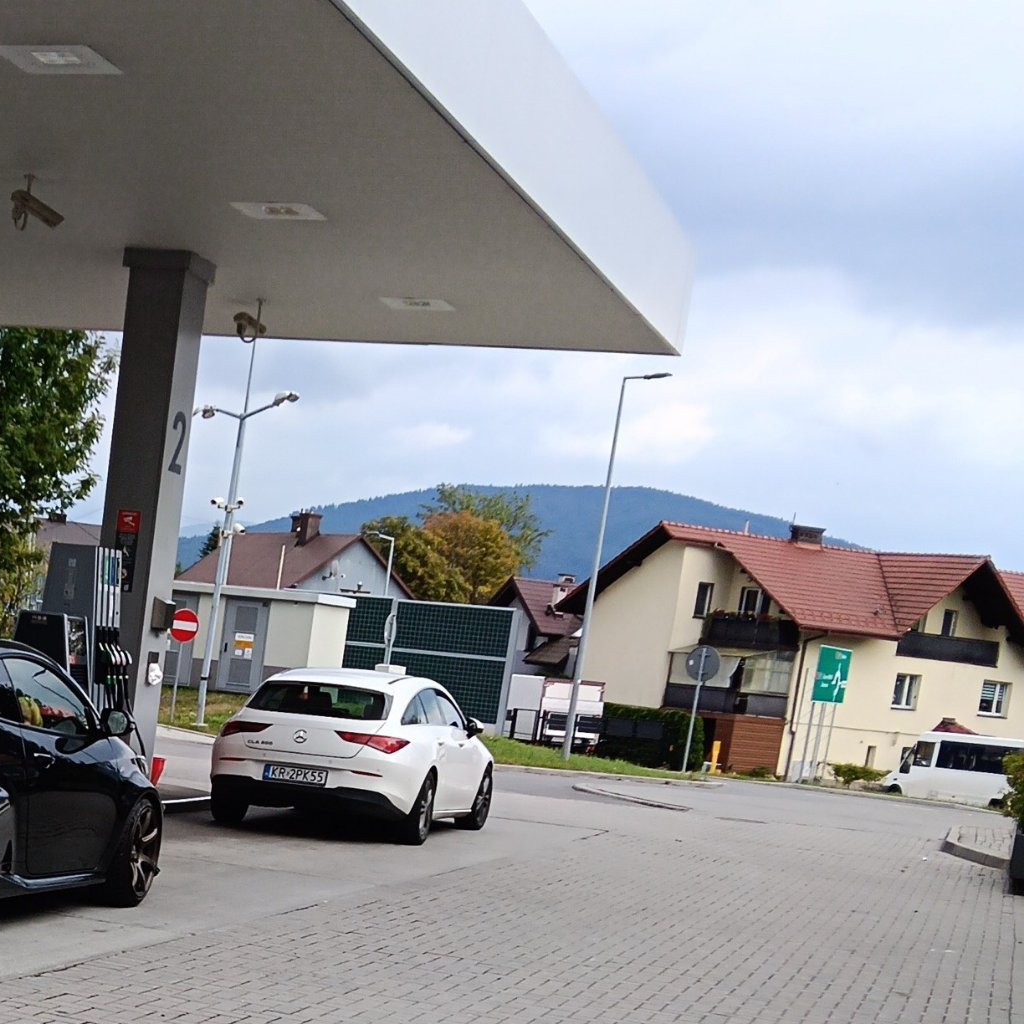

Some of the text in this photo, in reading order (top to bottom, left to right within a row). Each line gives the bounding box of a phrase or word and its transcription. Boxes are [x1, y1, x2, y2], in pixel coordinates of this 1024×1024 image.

[168, 410, 187, 475] 2
[271, 767, 324, 782] KR 2PK55
